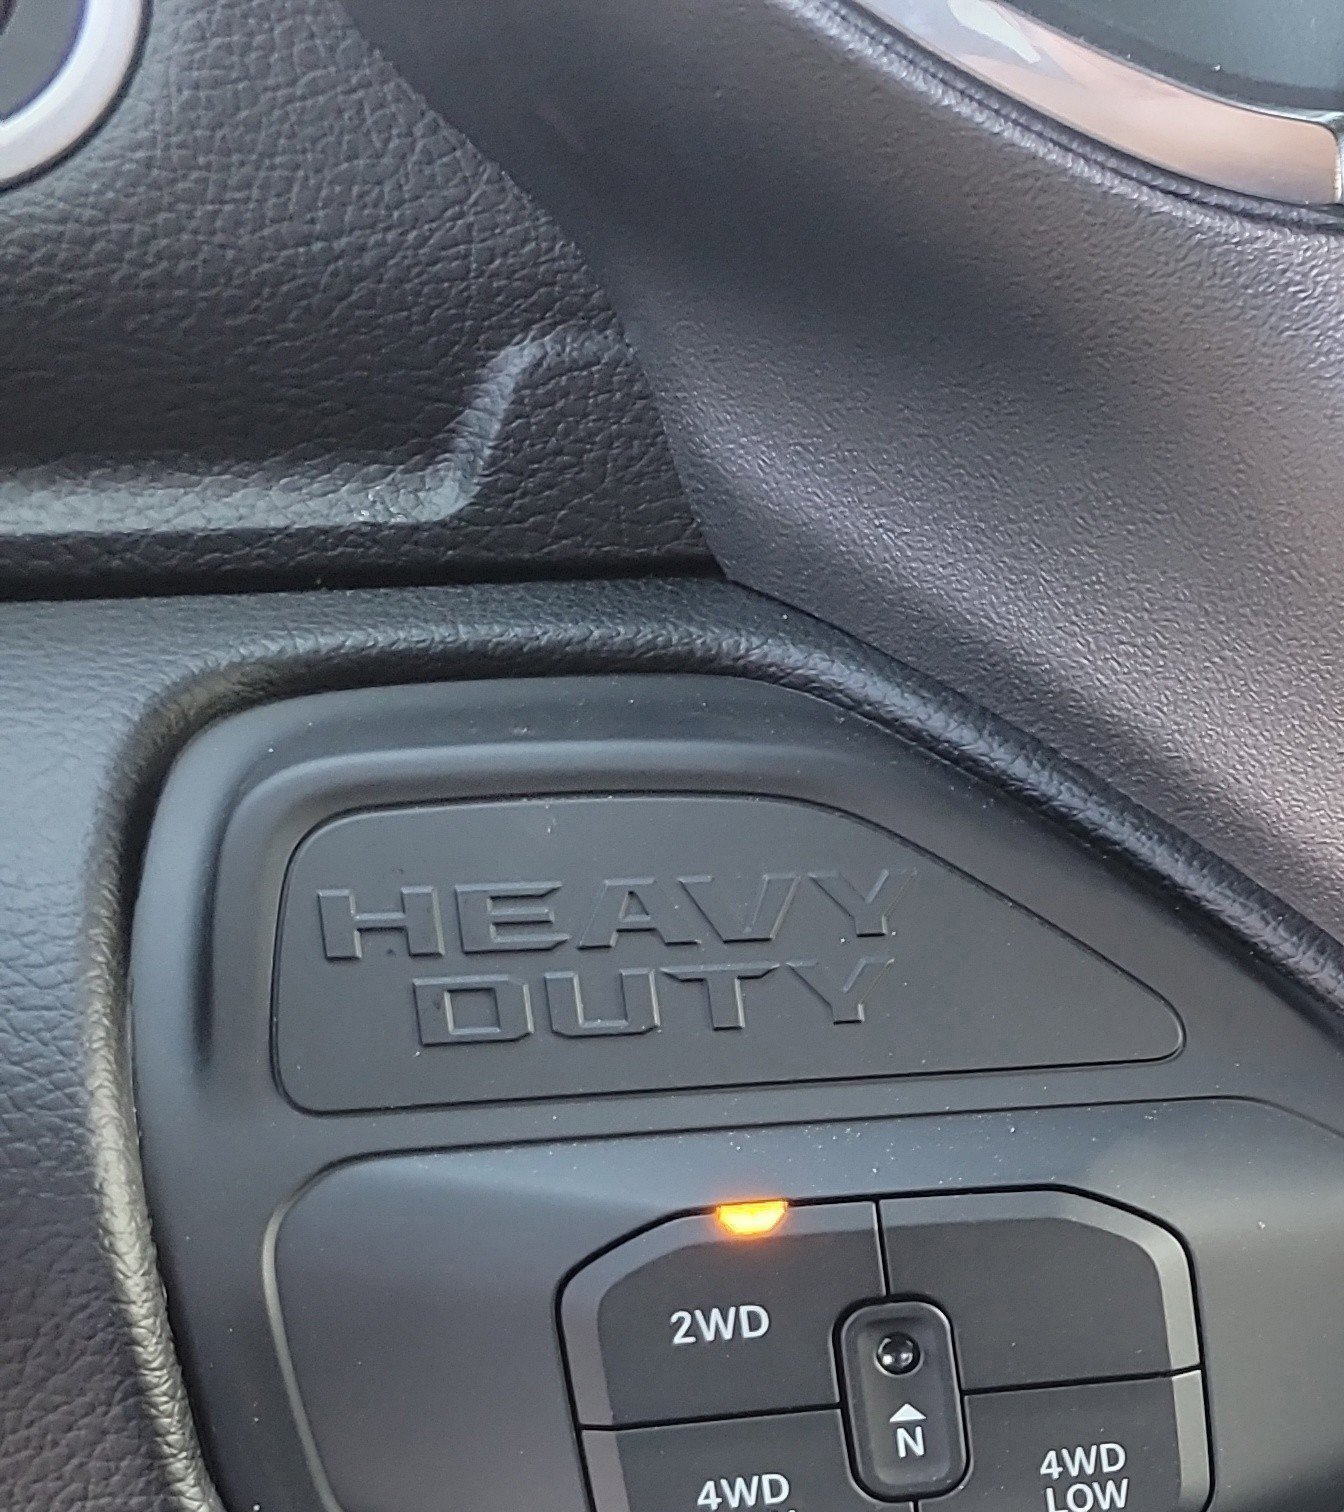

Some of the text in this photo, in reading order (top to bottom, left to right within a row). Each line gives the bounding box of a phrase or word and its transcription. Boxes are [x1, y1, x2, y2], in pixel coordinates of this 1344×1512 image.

[316, 868, 916, 960] HEAVY
[412, 956, 895, 1046] DUTY
[670, 1305, 771, 1345] 2WD
[897, 1427, 925, 1458] N
[1040, 1442, 1127, 1480] 4WD
[697, 1473, 790, 1512] 4WD
